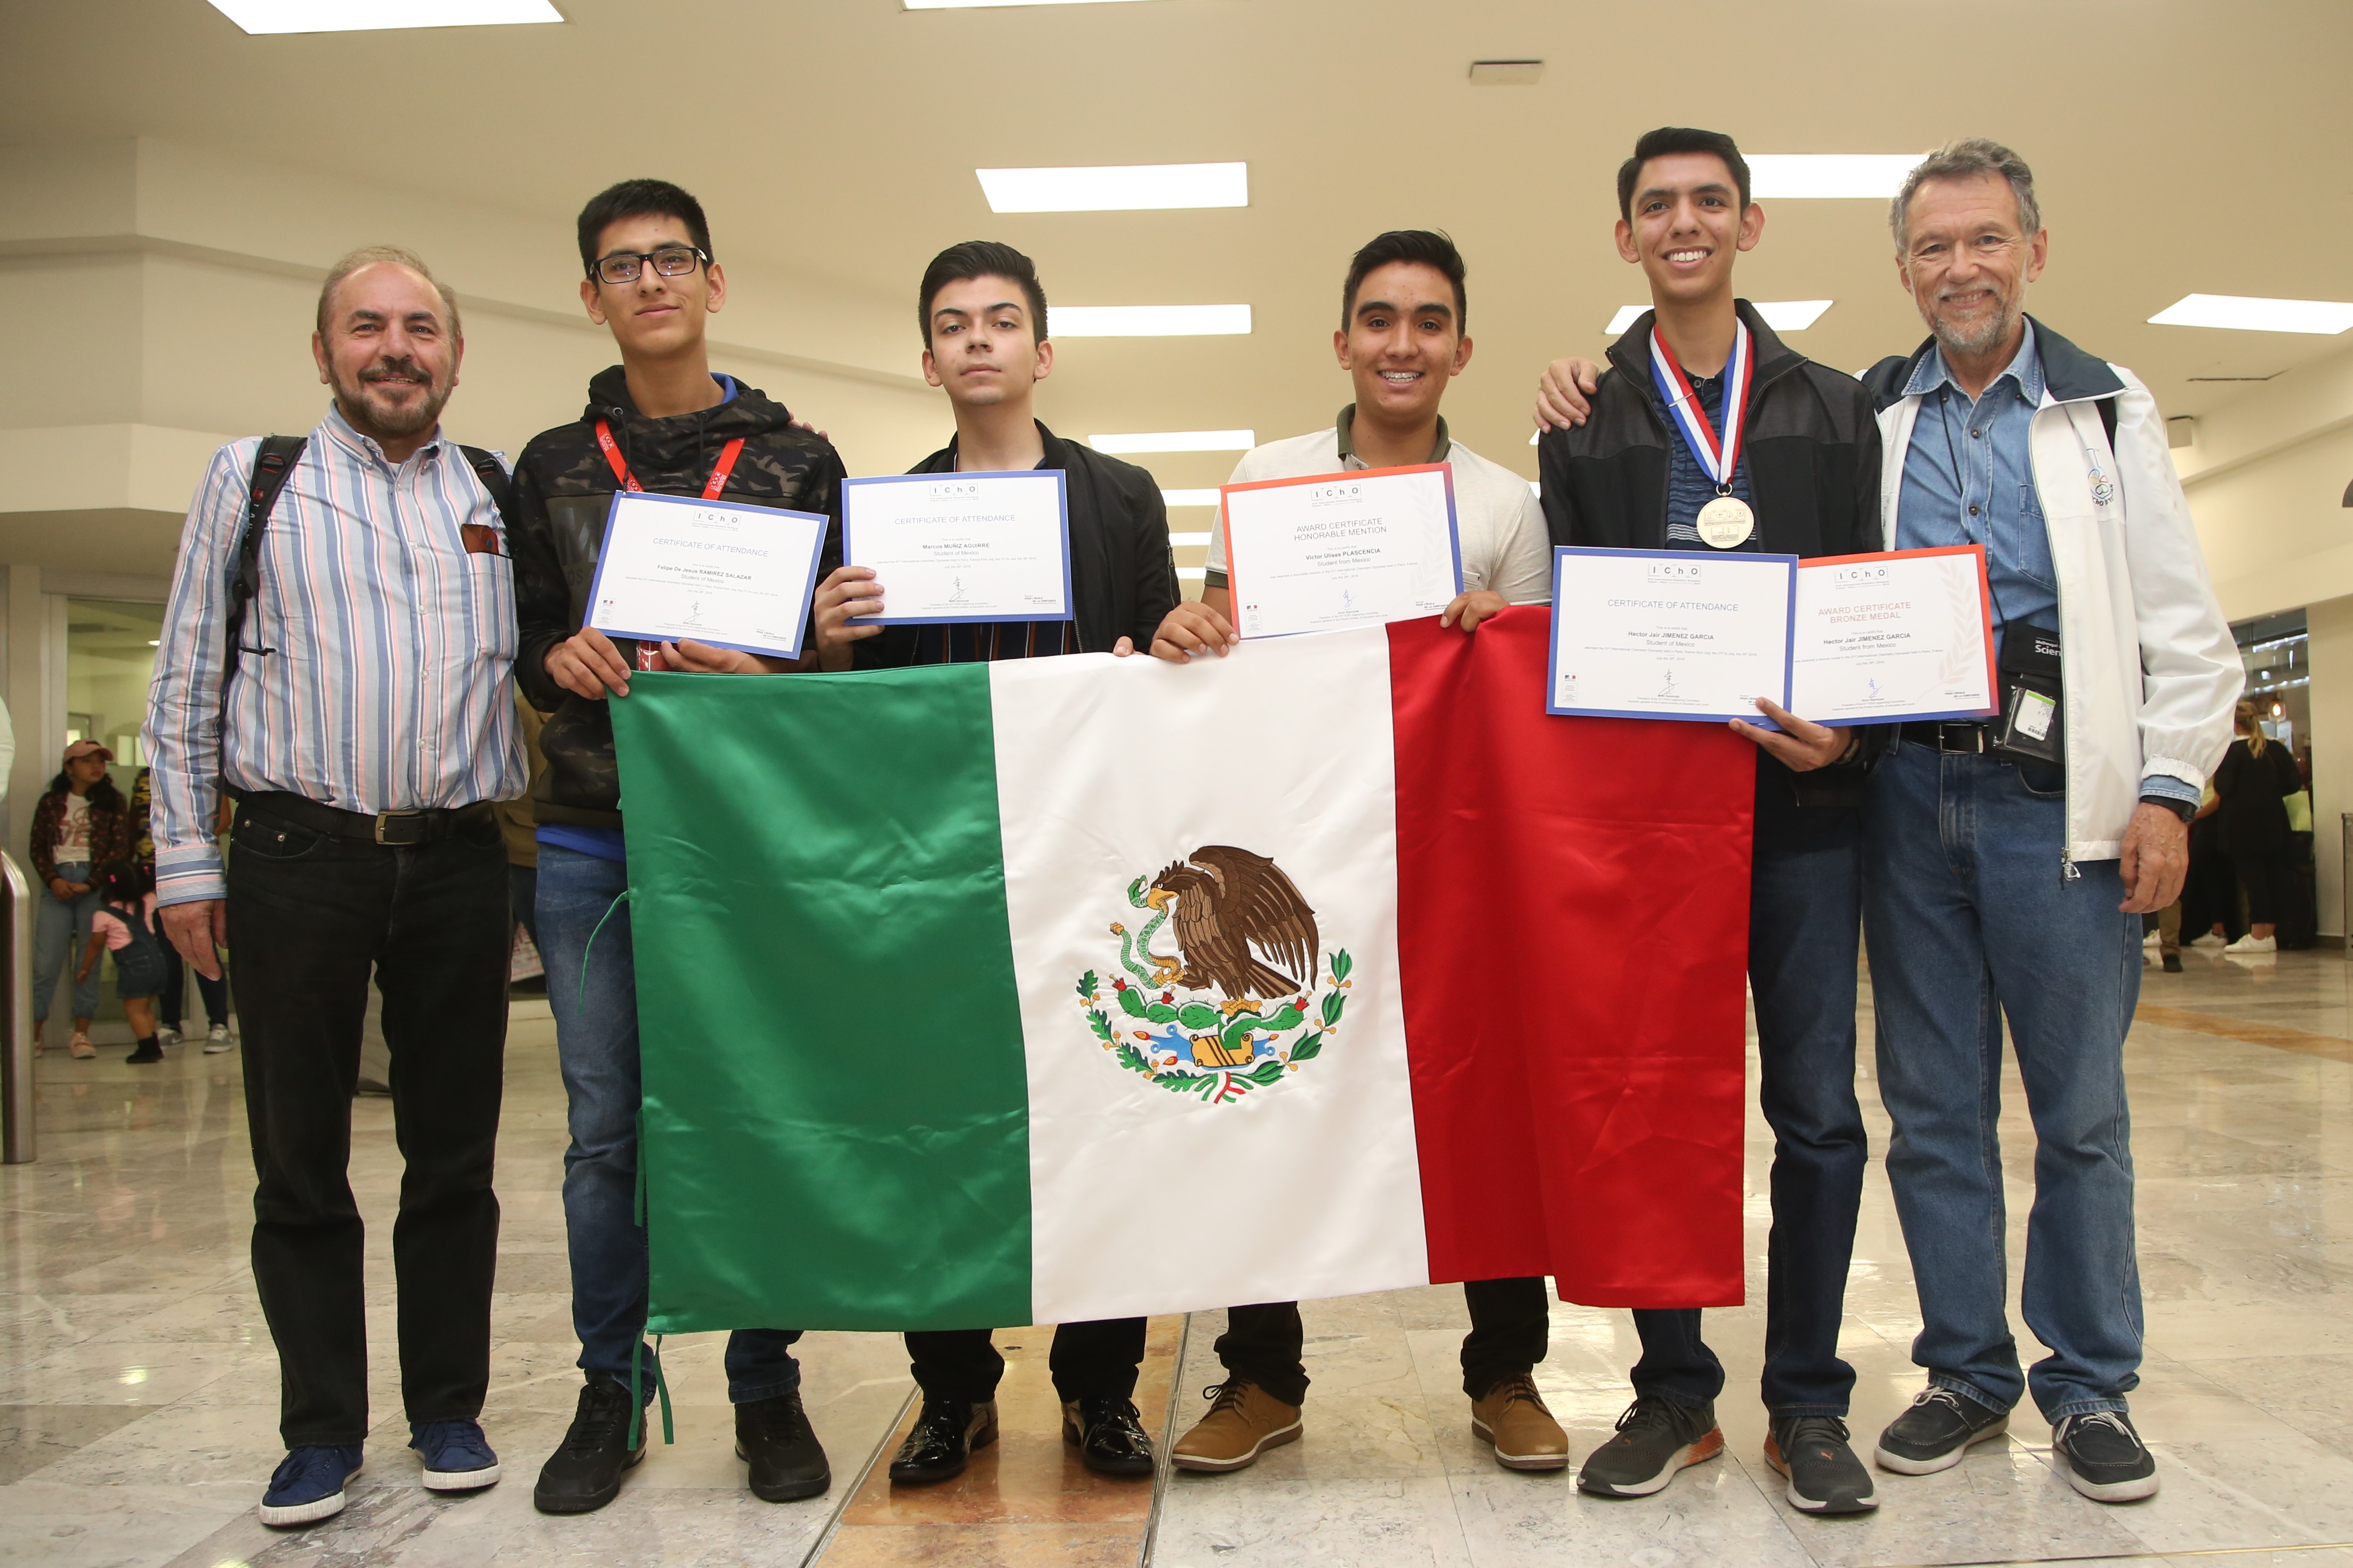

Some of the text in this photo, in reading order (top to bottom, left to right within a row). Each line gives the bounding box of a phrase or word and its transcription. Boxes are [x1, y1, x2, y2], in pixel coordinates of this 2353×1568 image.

[961, 514, 1015, 523] ATTENDANCE
[1296, 517, 1382, 533] AWARD CERTIFICATE
[1294, 526, 1386, 541] HONORABLE MENTION
[652, 537, 702, 549] CERTIFICATE
[715, 545, 768, 556] ATTENDANCE
[1343, 548, 1381, 556] PLASCENCIA
[1608, 599, 1663, 608] CERTIFICATE
[1679, 602, 1738, 611] ATTENDANCE
[1818, 601, 1911, 615] AWARD CERTIFICATE
[1830, 611, 1901, 623] BRONZE MEDAL
